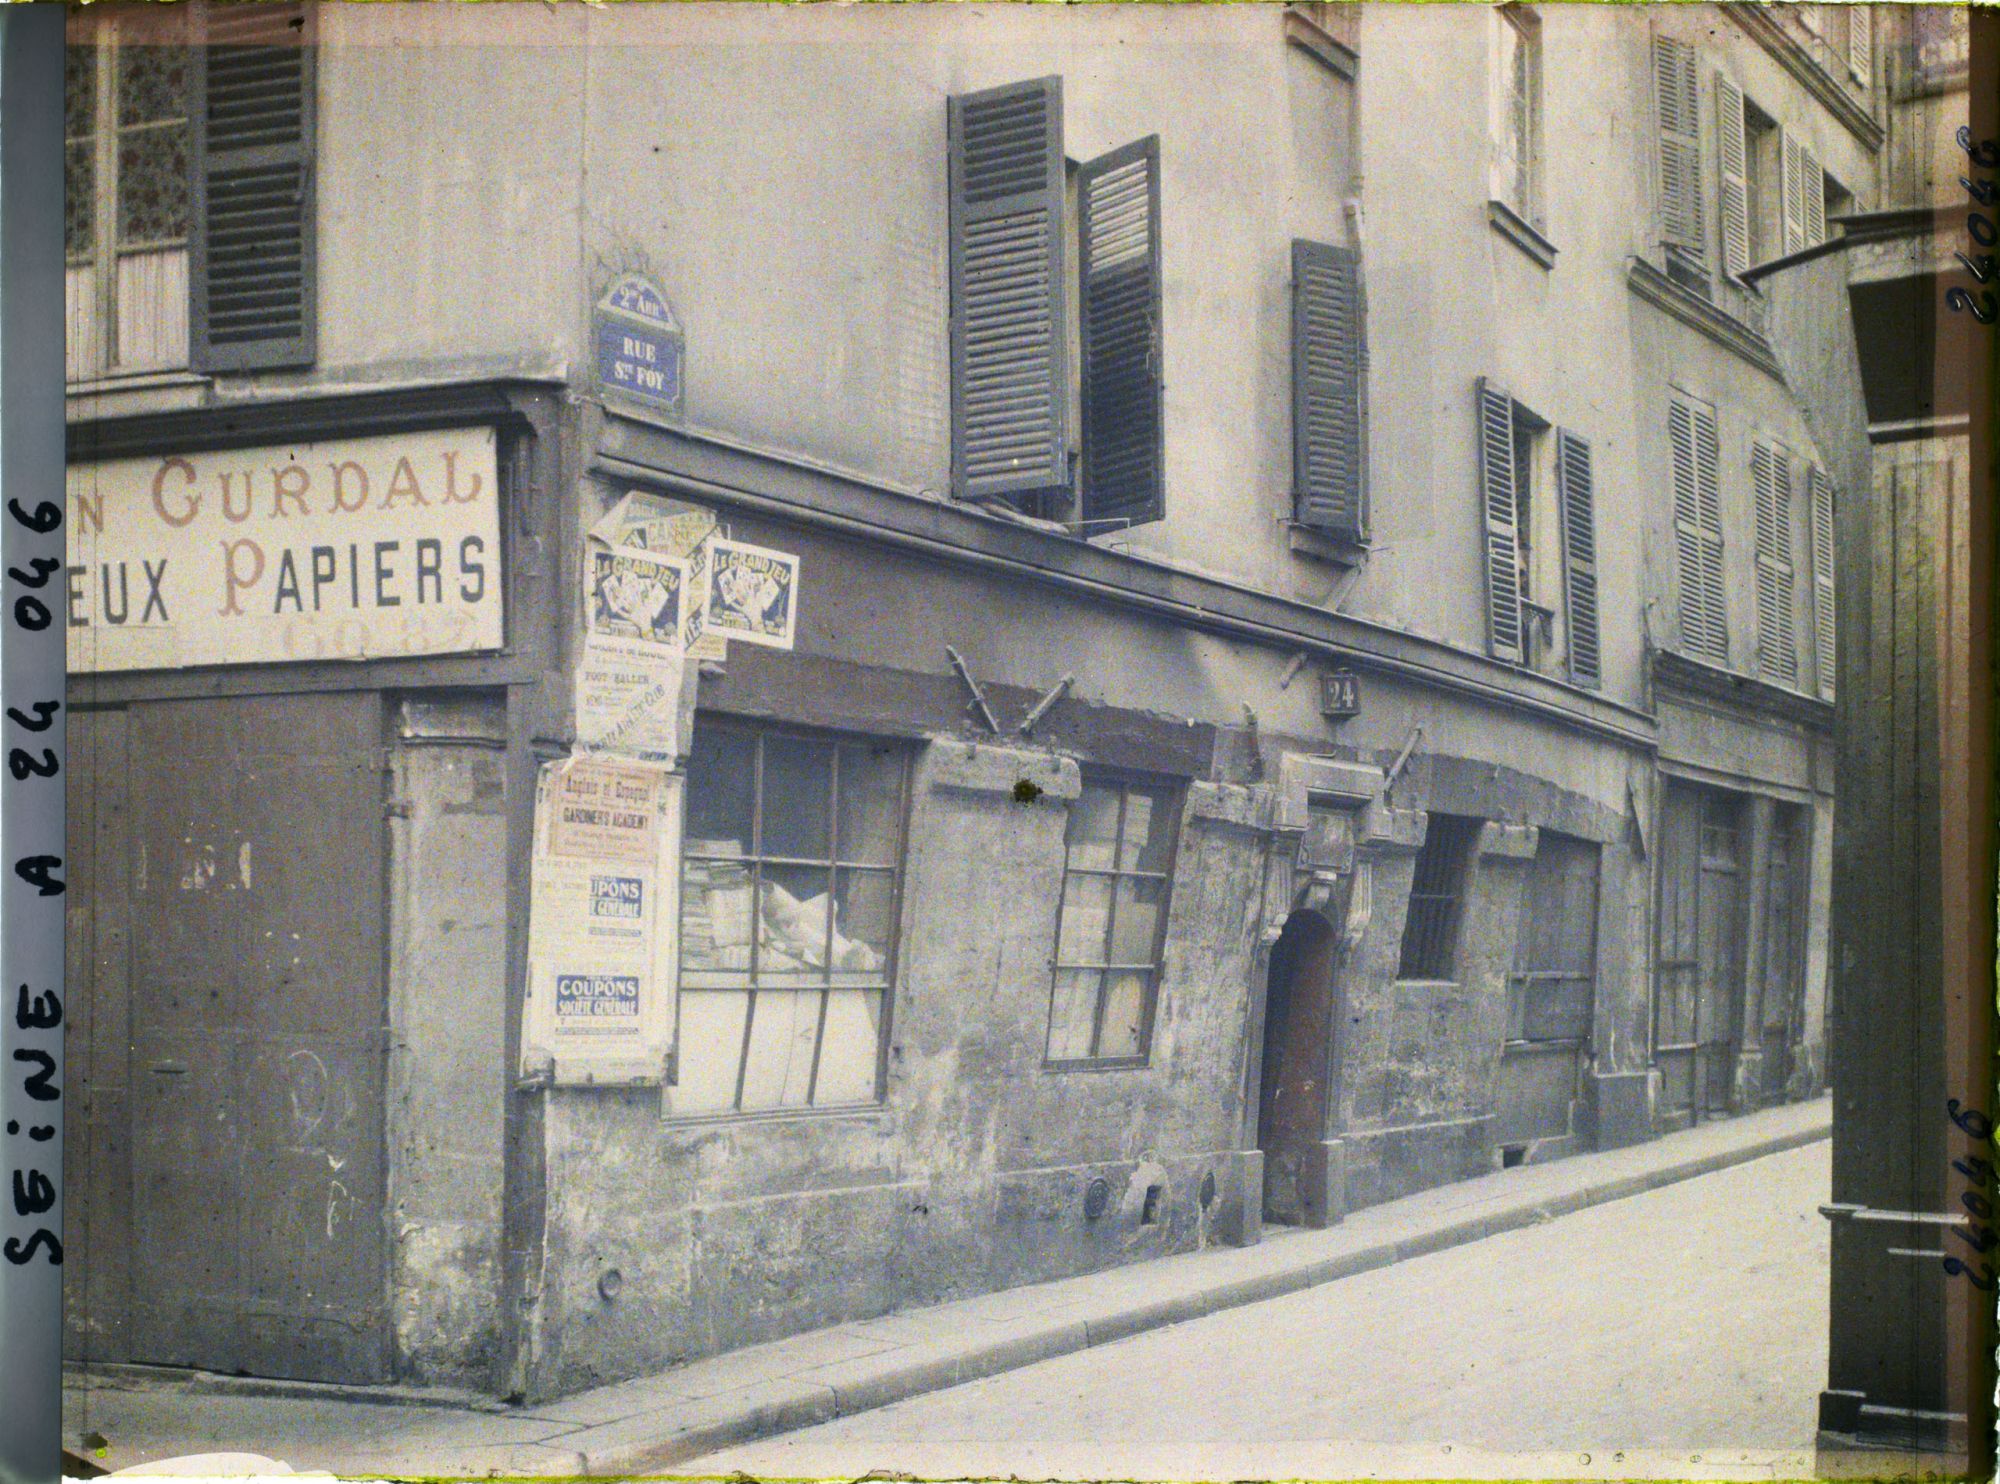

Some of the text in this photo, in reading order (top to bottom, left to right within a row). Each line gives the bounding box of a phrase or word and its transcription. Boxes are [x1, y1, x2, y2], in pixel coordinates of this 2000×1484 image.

[623, 336, 656, 363] RUE
[636, 366, 665, 390] FOY
[218, 534, 486, 617] PAPIERS
[612, 556, 657, 578] GRAND
[654, 565, 679, 590] JEU
[728, 552, 770, 572] GRAND
[767, 562, 791, 585] JEU
[1329, 680, 1355, 709] 24
[15, 856, 64, 896] A
[559, 979, 637, 997] COUPONS
